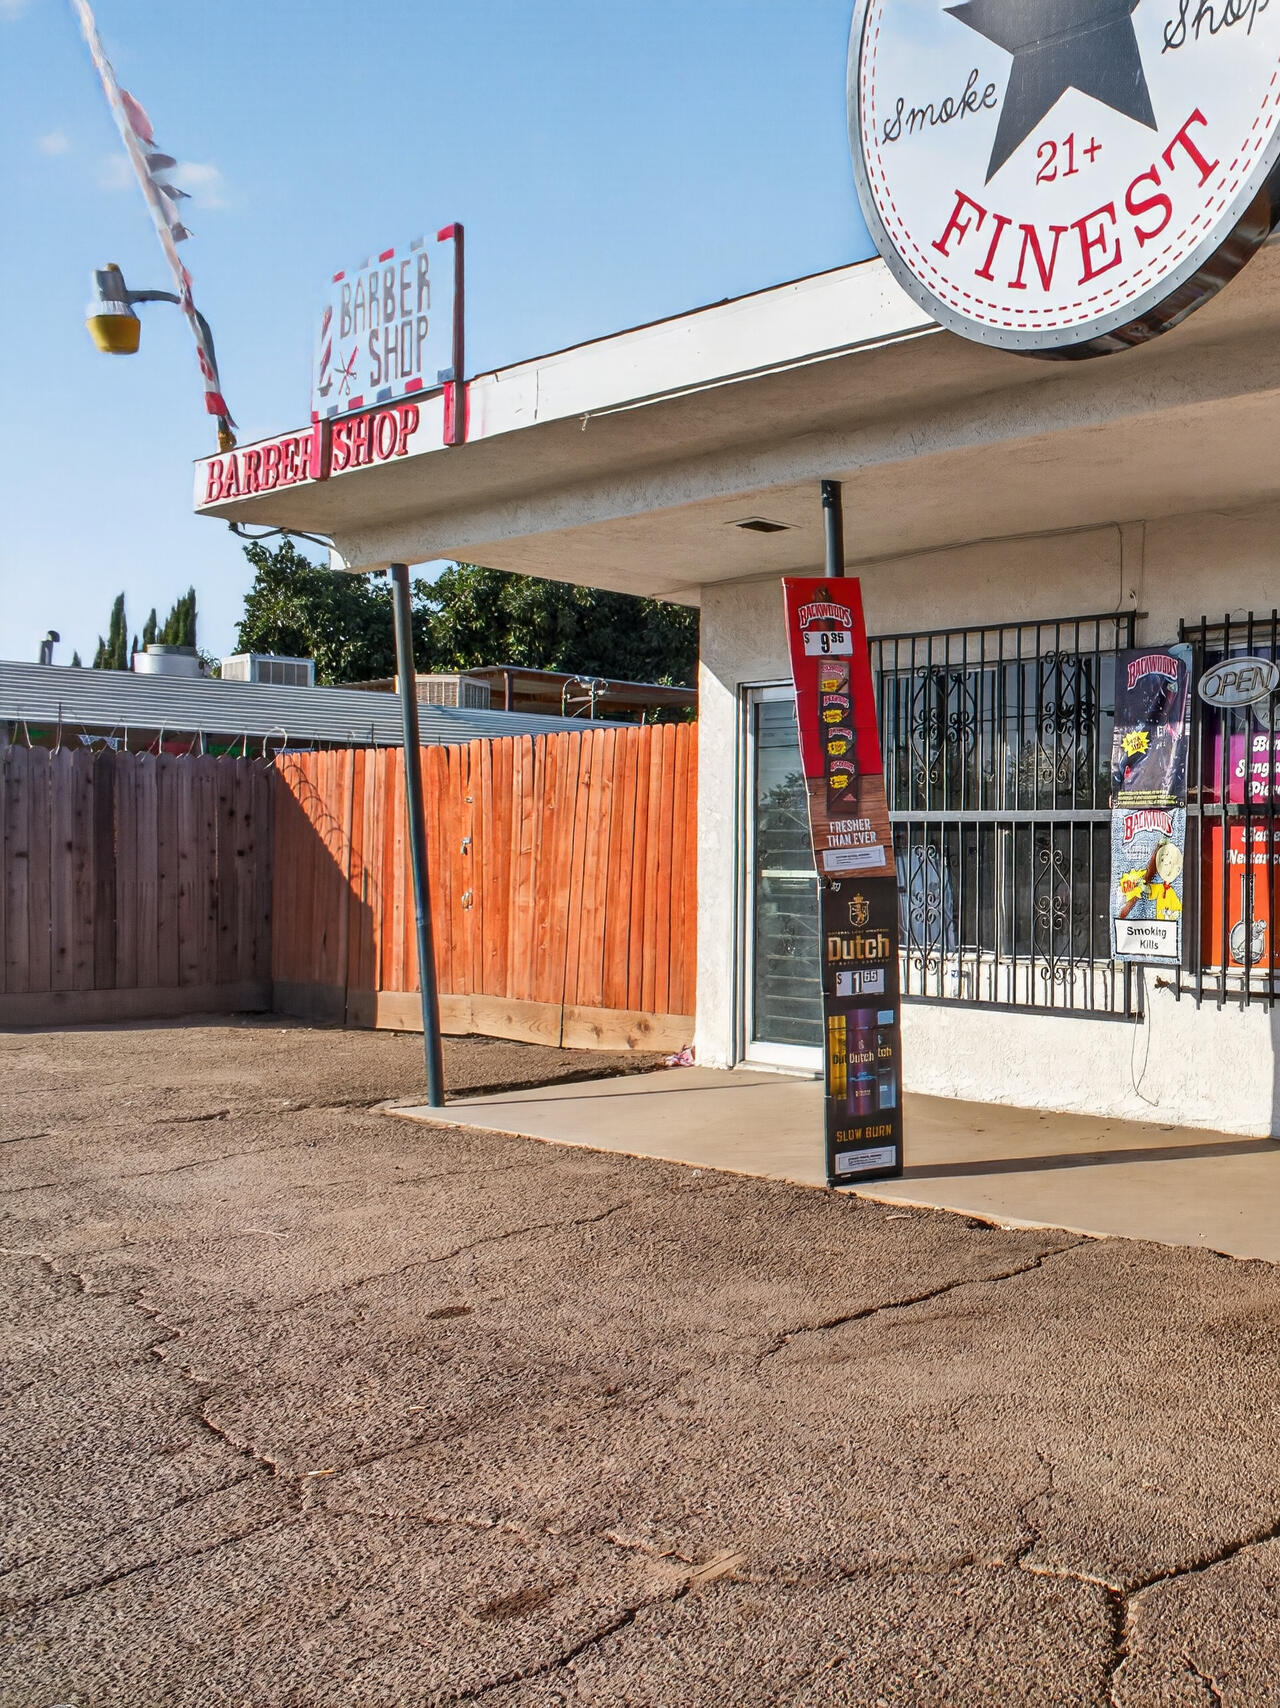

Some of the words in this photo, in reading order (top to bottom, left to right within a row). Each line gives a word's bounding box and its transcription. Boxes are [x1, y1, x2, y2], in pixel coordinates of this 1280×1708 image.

[882, 69, 997, 144] Smoke
[1035, 132, 1103, 186] 21+
[931, 108, 1220, 292] FINEST
[339, 252, 431, 339] BARBER
[368, 315, 429, 388] SHOP
[332, 403, 420, 472] SHOP
[798, 601, 853, 629] BACKWOODS
[1127, 654, 1178, 691] BACKWOODS
[1203, 666, 1273, 699] OPEN
[826, 833, 852, 848] THAN
[853, 831, 877, 845] EVER
[829, 818, 872, 833] FRESHER
[827, 933, 890, 961] Dutch
[1139, 939, 1159, 950] Kills
[849, 1051, 875, 1064] Dutch
[836, 1128, 862, 1143] SLOW
[865, 1123, 892, 1139] BURN
